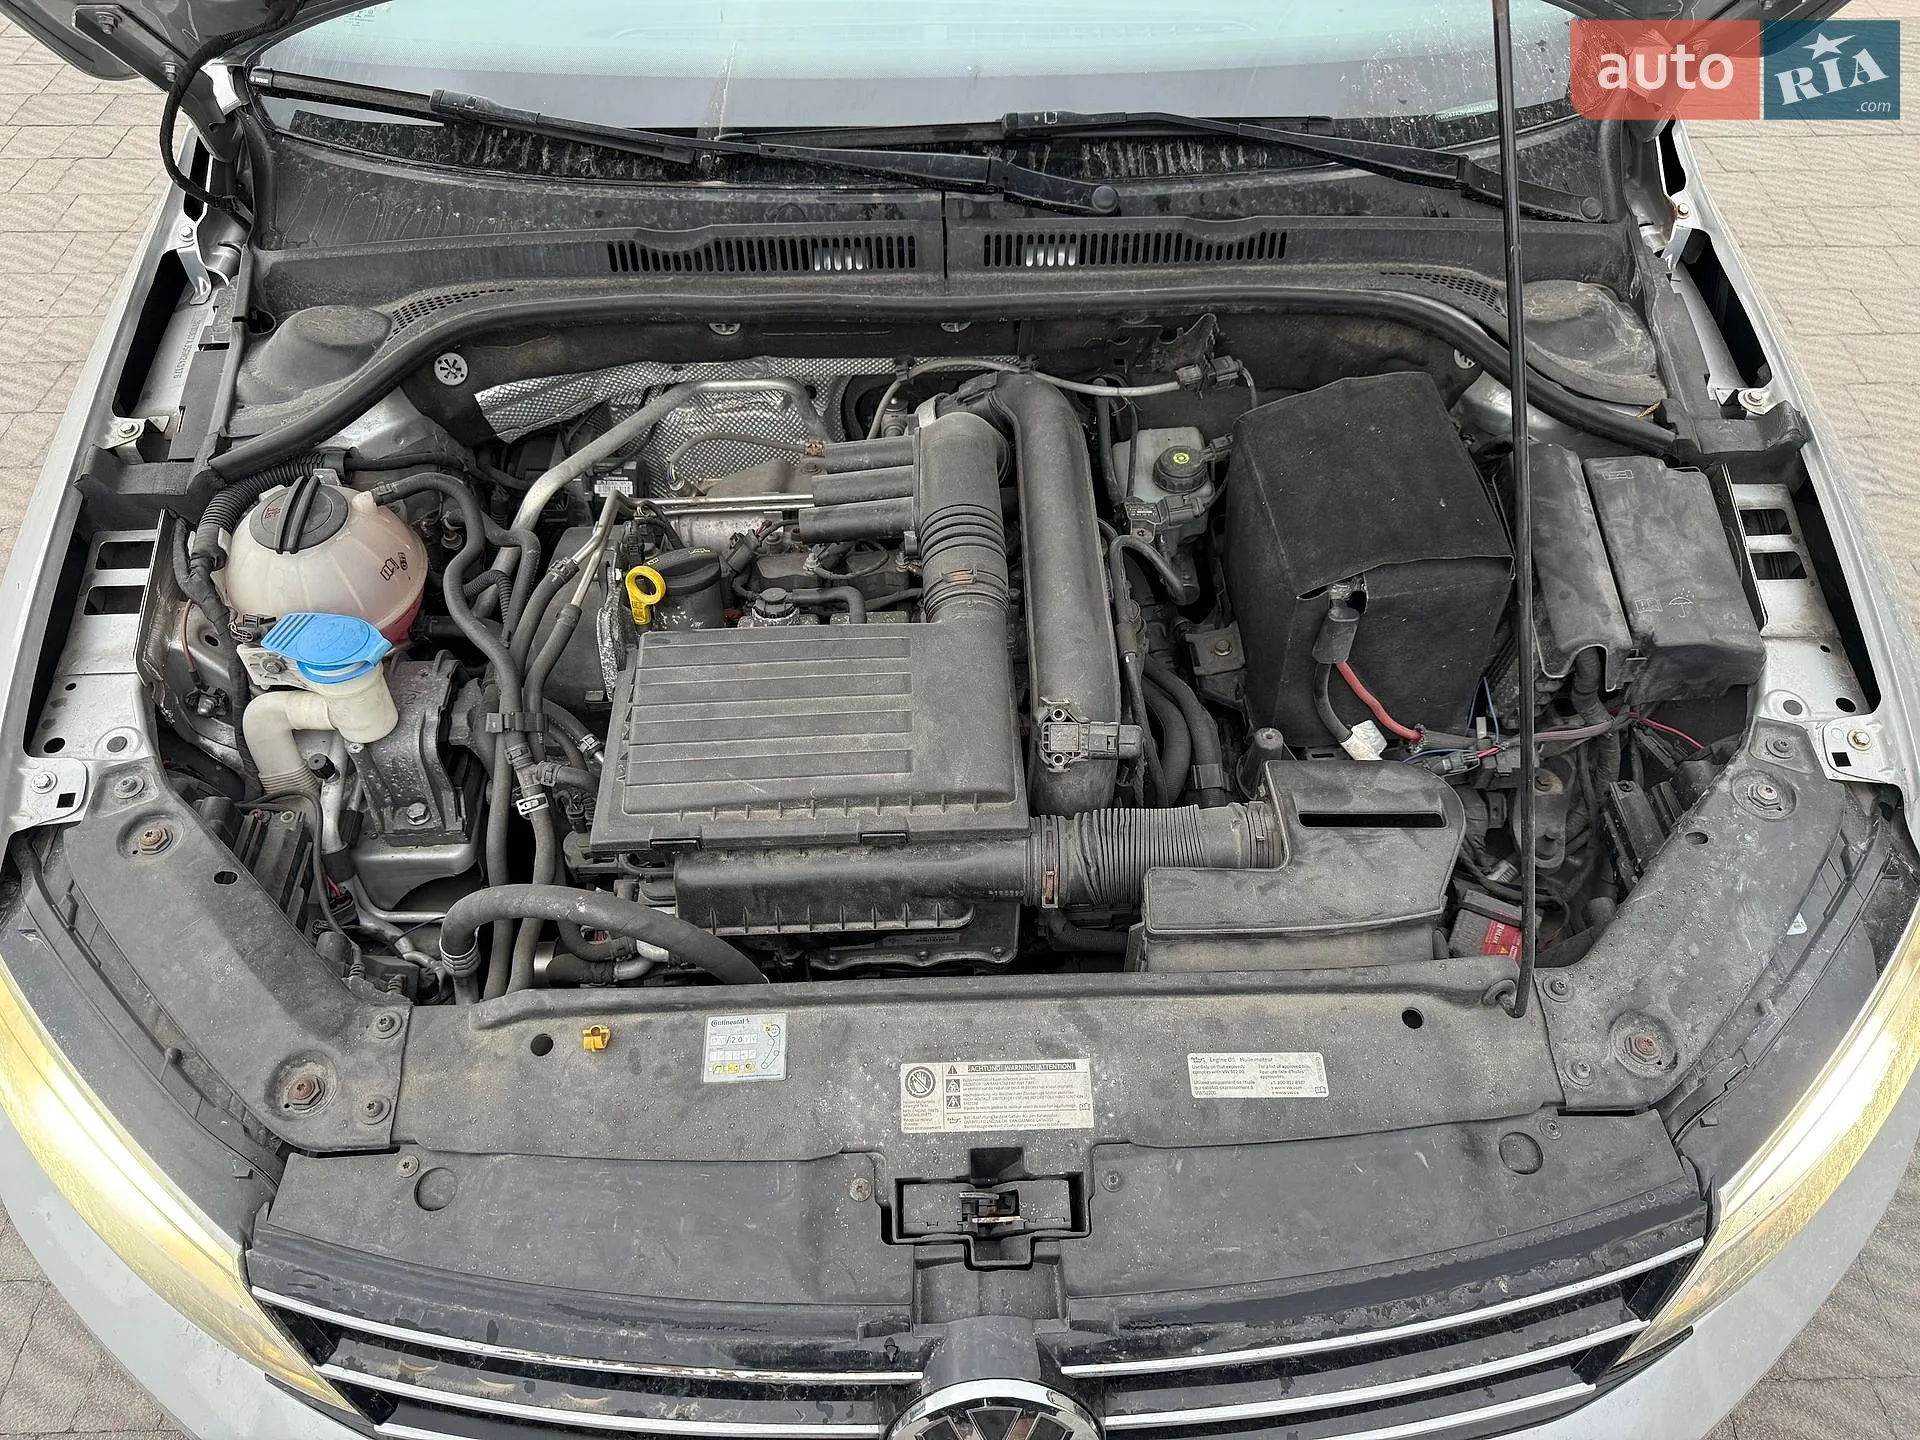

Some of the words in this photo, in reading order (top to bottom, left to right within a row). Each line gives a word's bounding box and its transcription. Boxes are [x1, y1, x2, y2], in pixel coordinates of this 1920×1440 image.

[710, 1018, 745, 1028] Continental
[1004, 1063, 1037, 1072] WARNING!
[1038, 1062, 1075, 1071] ATTENTION!
